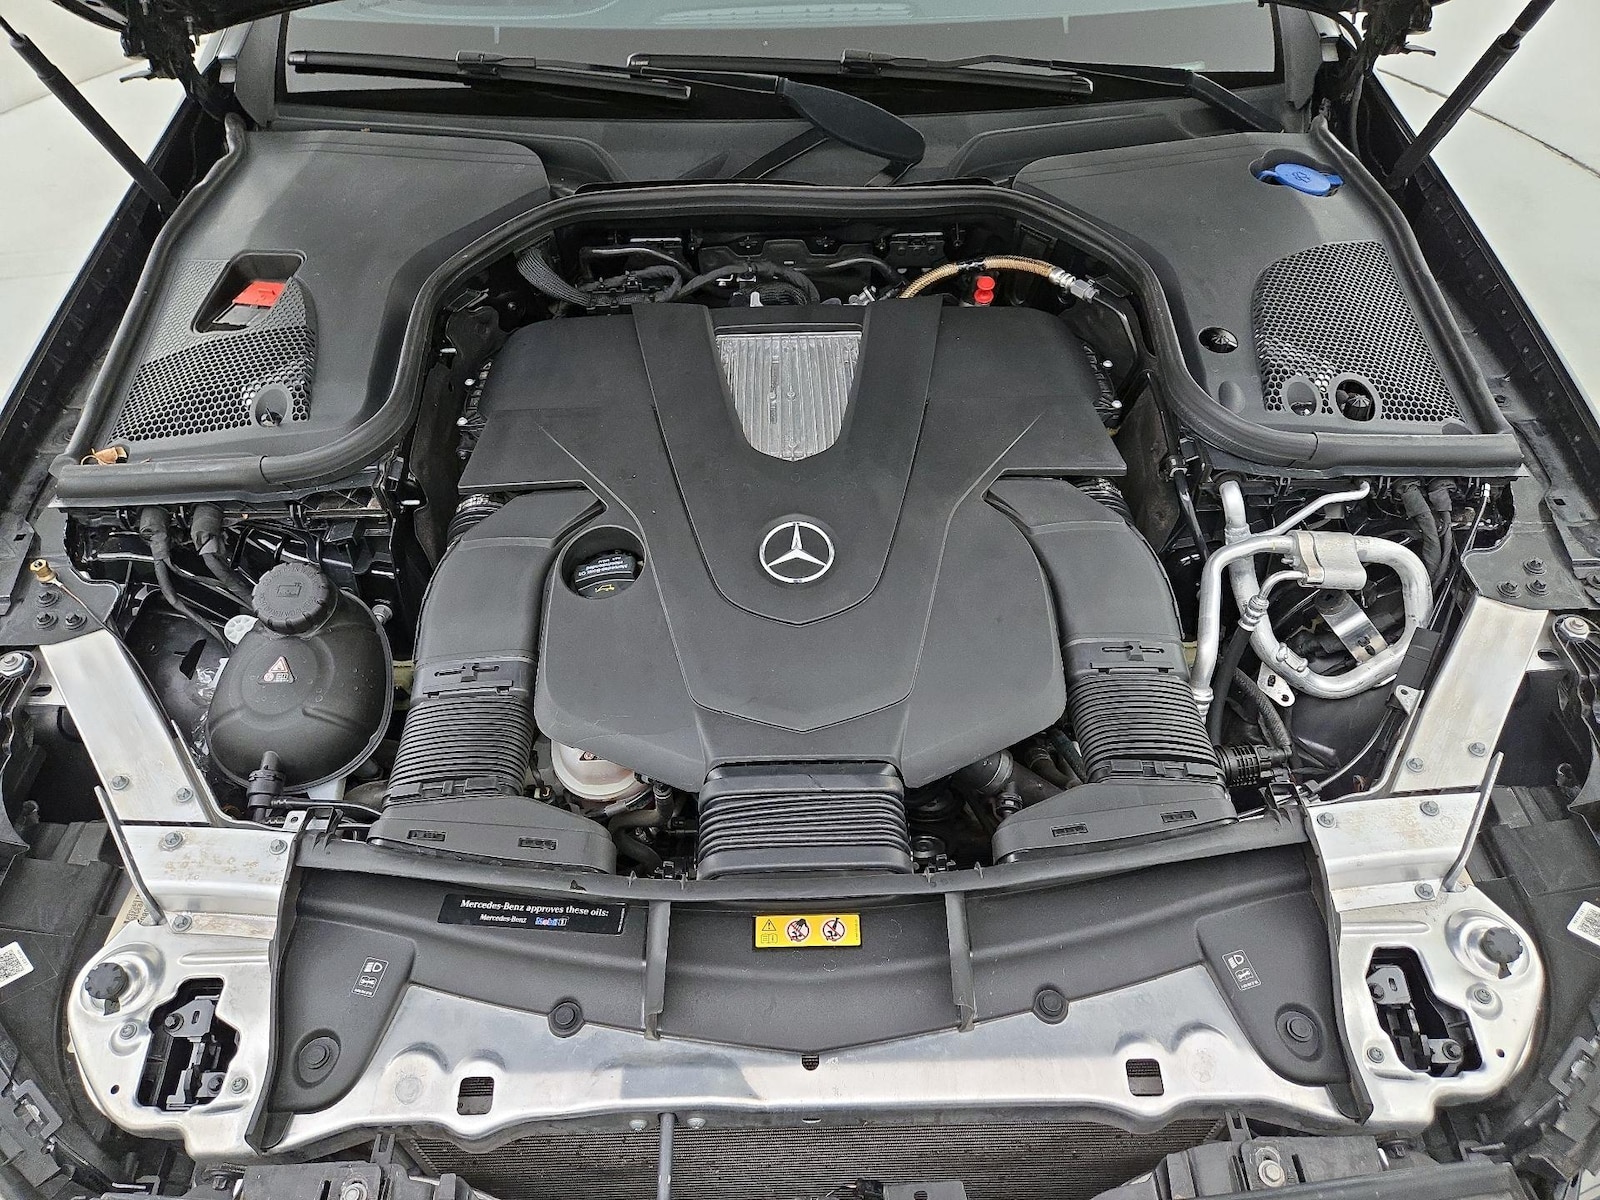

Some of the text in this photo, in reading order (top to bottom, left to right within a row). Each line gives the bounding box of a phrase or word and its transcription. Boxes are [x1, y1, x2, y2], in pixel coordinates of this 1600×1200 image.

[460, 899, 609, 917] Mercedes-Benz approves these oils:
[479, 913, 527, 924] Mercedes-Benz
